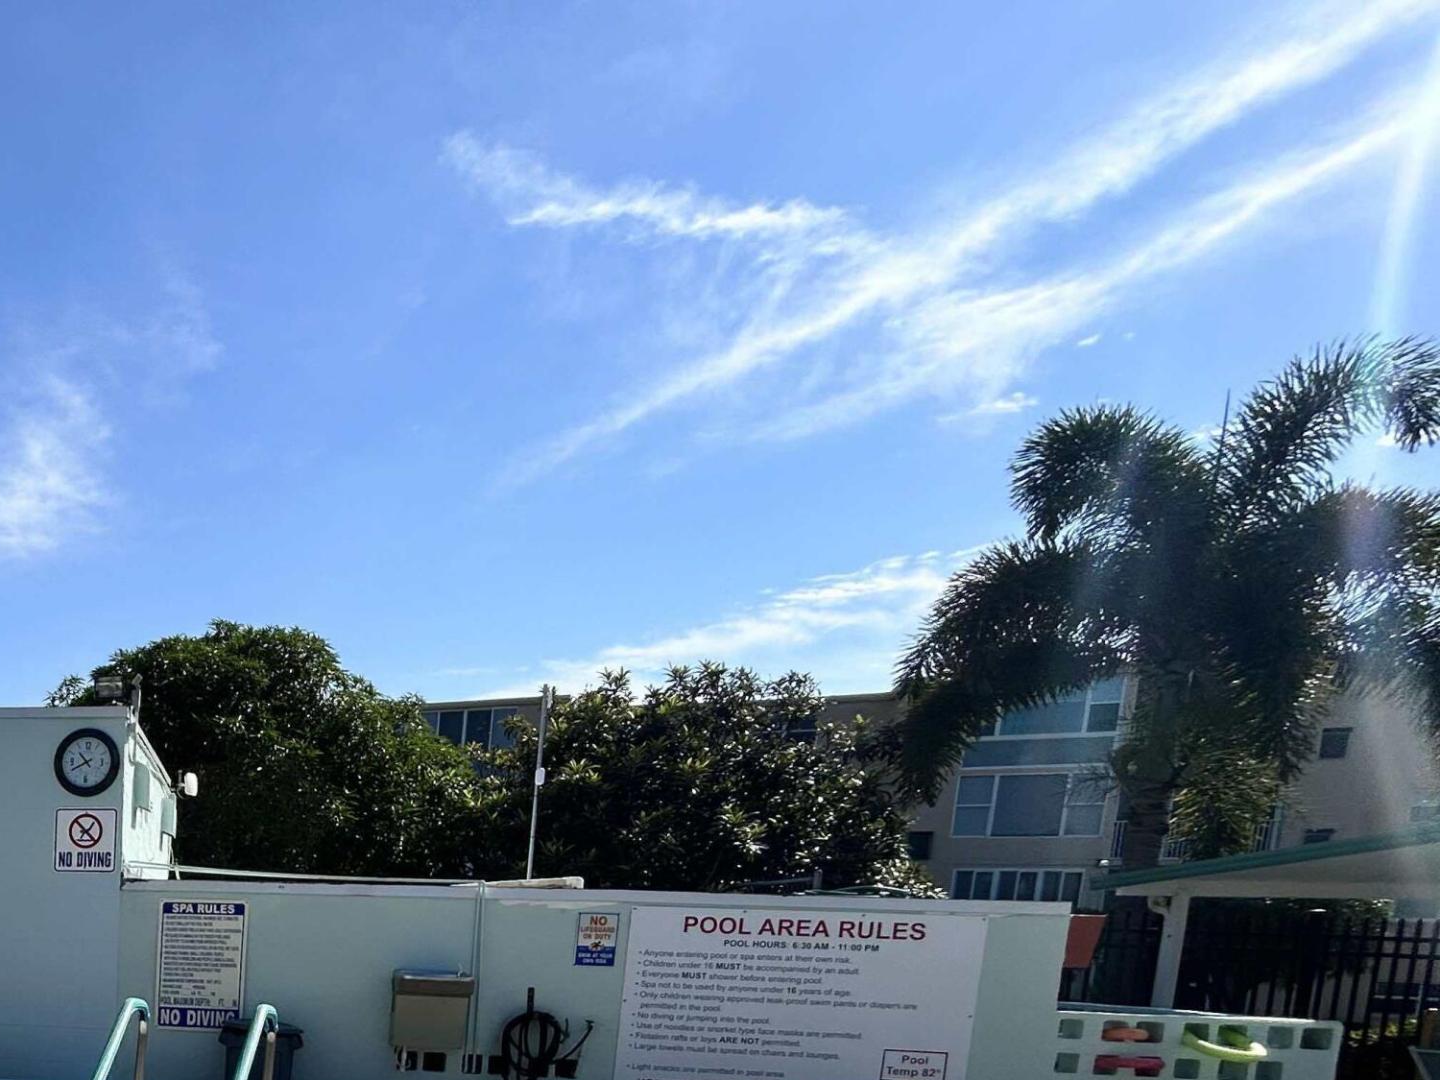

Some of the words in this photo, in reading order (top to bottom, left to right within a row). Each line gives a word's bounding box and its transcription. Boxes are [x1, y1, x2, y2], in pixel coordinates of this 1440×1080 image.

[59, 852, 72, 867] NO
[77, 852, 111, 868] DIVING
[172, 904, 194, 913] SPA
[197, 904, 235, 914] RULES
[591, 916, 608, 926] NO
[683, 916, 751, 935] POOL
[758, 918, 829, 937] AREA
[838, 920, 927, 940] RULES
[723, 939, 749, 948] POOL
[792, 942, 812, 950] 6:30
[643, 949, 674, 958] Anyone
[676, 951, 708, 959] entering
[710, 952, 728, 960] pool
[642, 960, 676, 968] Children
[743, 963, 753, 971] be
[755, 965, 810, 974] accompanied
[813, 966, 822, 975] by
[641, 970, 680, 979] Everyone
[768, 976, 801, 985] entering
[716, 984, 726, 992] by
[727, 985, 758, 993] anyone
[786, 986, 797, 994] 16
[798, 988, 822, 996] years
[640, 990, 658, 1000] Only
[660, 991, 691, 999] children
[693, 993, 724, 1002] wearing
[727, 996, 765, 1004] approved
[870, 1001, 901, 1010] diapers
[640, 1002, 678, 1010] permitted
[160, 1009, 180, 1025] NO
[637, 1011, 649, 1019] No
[651, 1012, 674, 1021] diving
[686, 1014, 717, 1023] jumping
[739, 1027, 756, 1035] type
[758, 1027, 775, 1035] face
[634, 1042, 657, 1051] Large
[761, 1049, 787, 1057] chairs
[901, 1055, 929, 1065] Pool
[631, 1063, 652, 1071] Light
[886, 1066, 918, 1077] Temp
